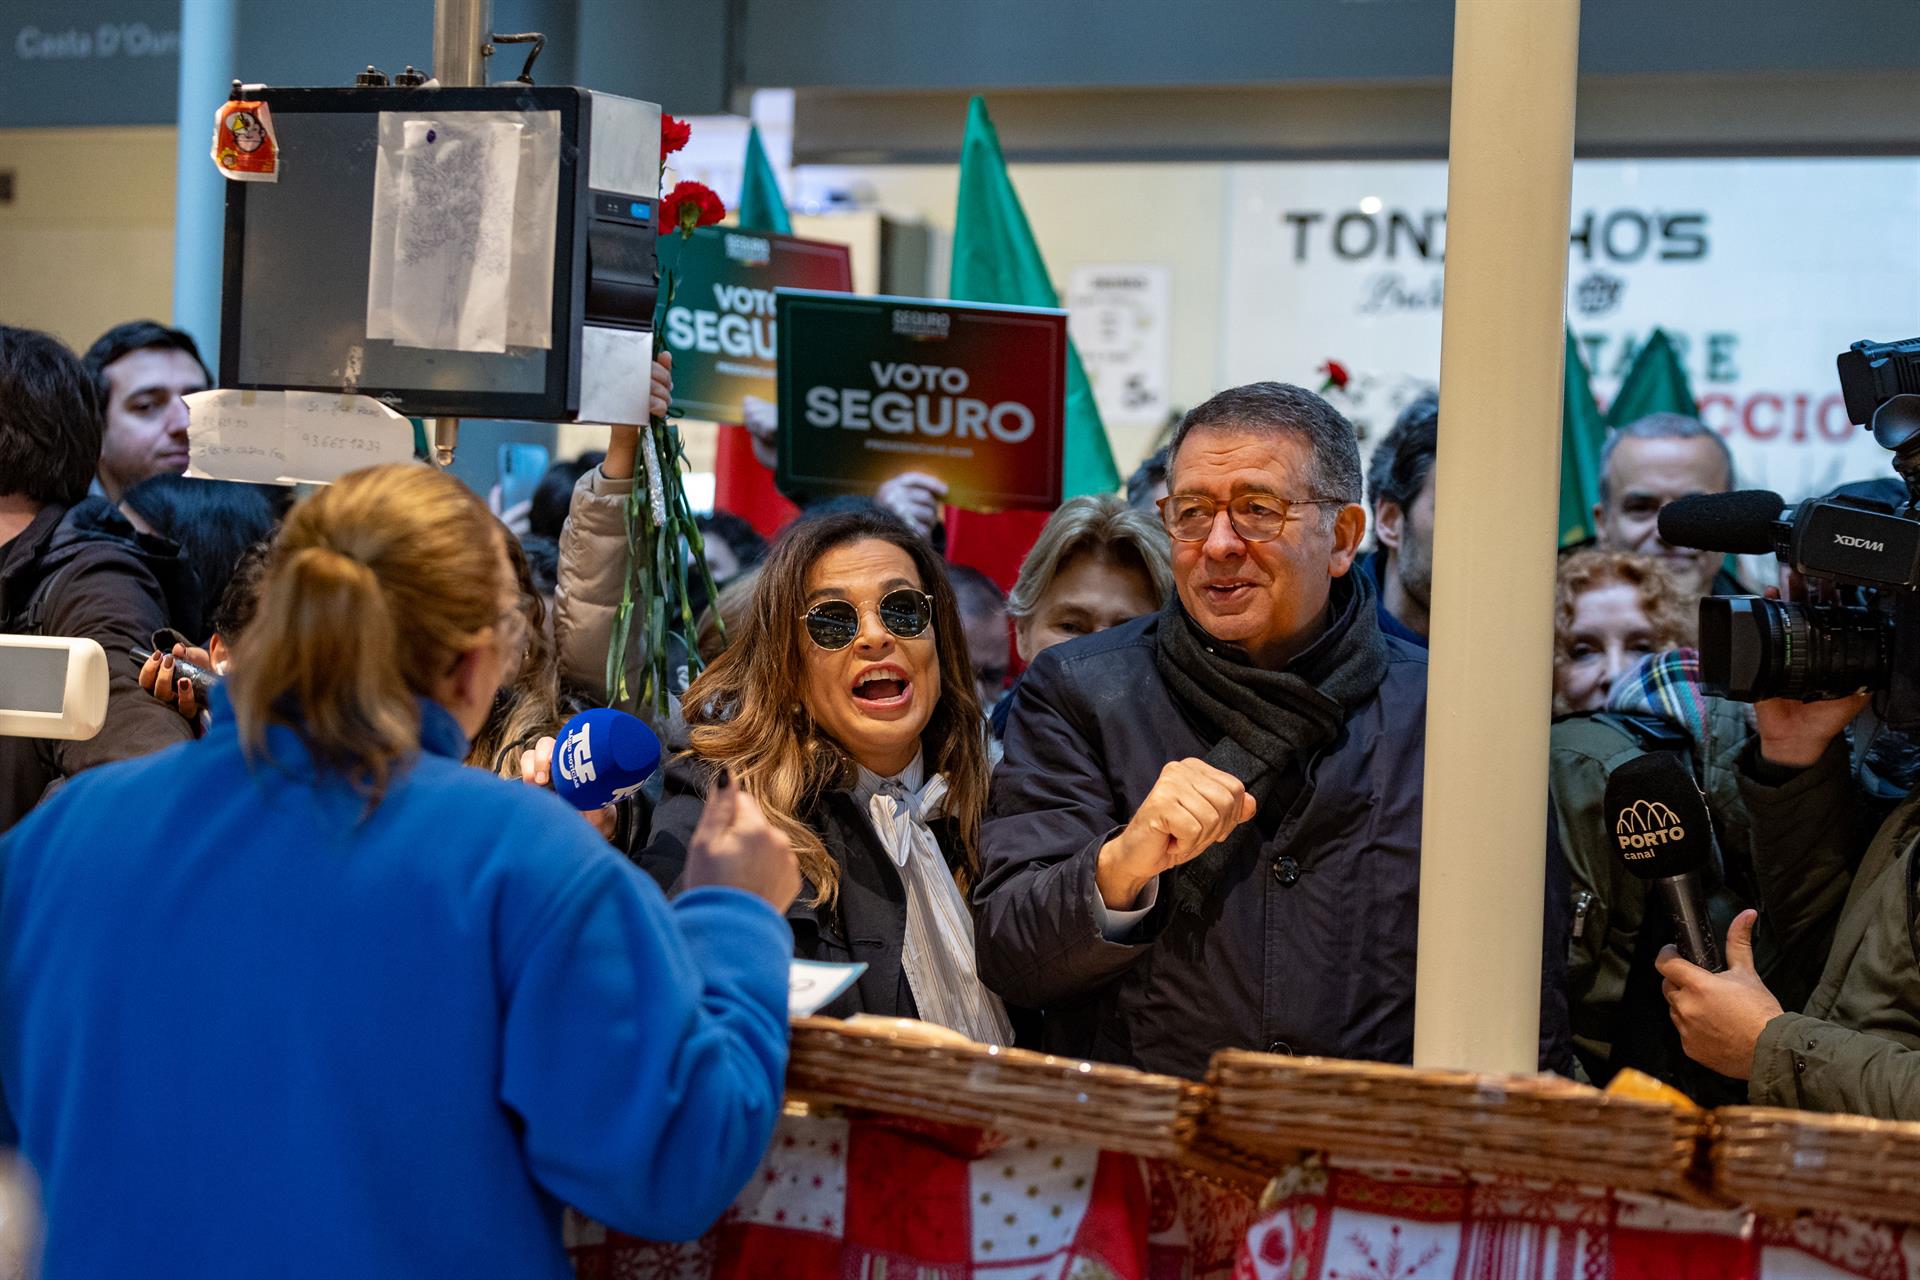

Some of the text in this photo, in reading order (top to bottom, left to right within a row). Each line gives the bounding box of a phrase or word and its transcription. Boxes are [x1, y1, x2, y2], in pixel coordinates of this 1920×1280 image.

[870, 361, 970, 394] VOTO
[805, 385, 1036, 444] SEGURO
[1833, 533, 1885, 552] XDCAM
[558, 722, 597, 784] TSF
[1618, 826, 1685, 849] PORTO
[1624, 848, 1656, 860] canal
